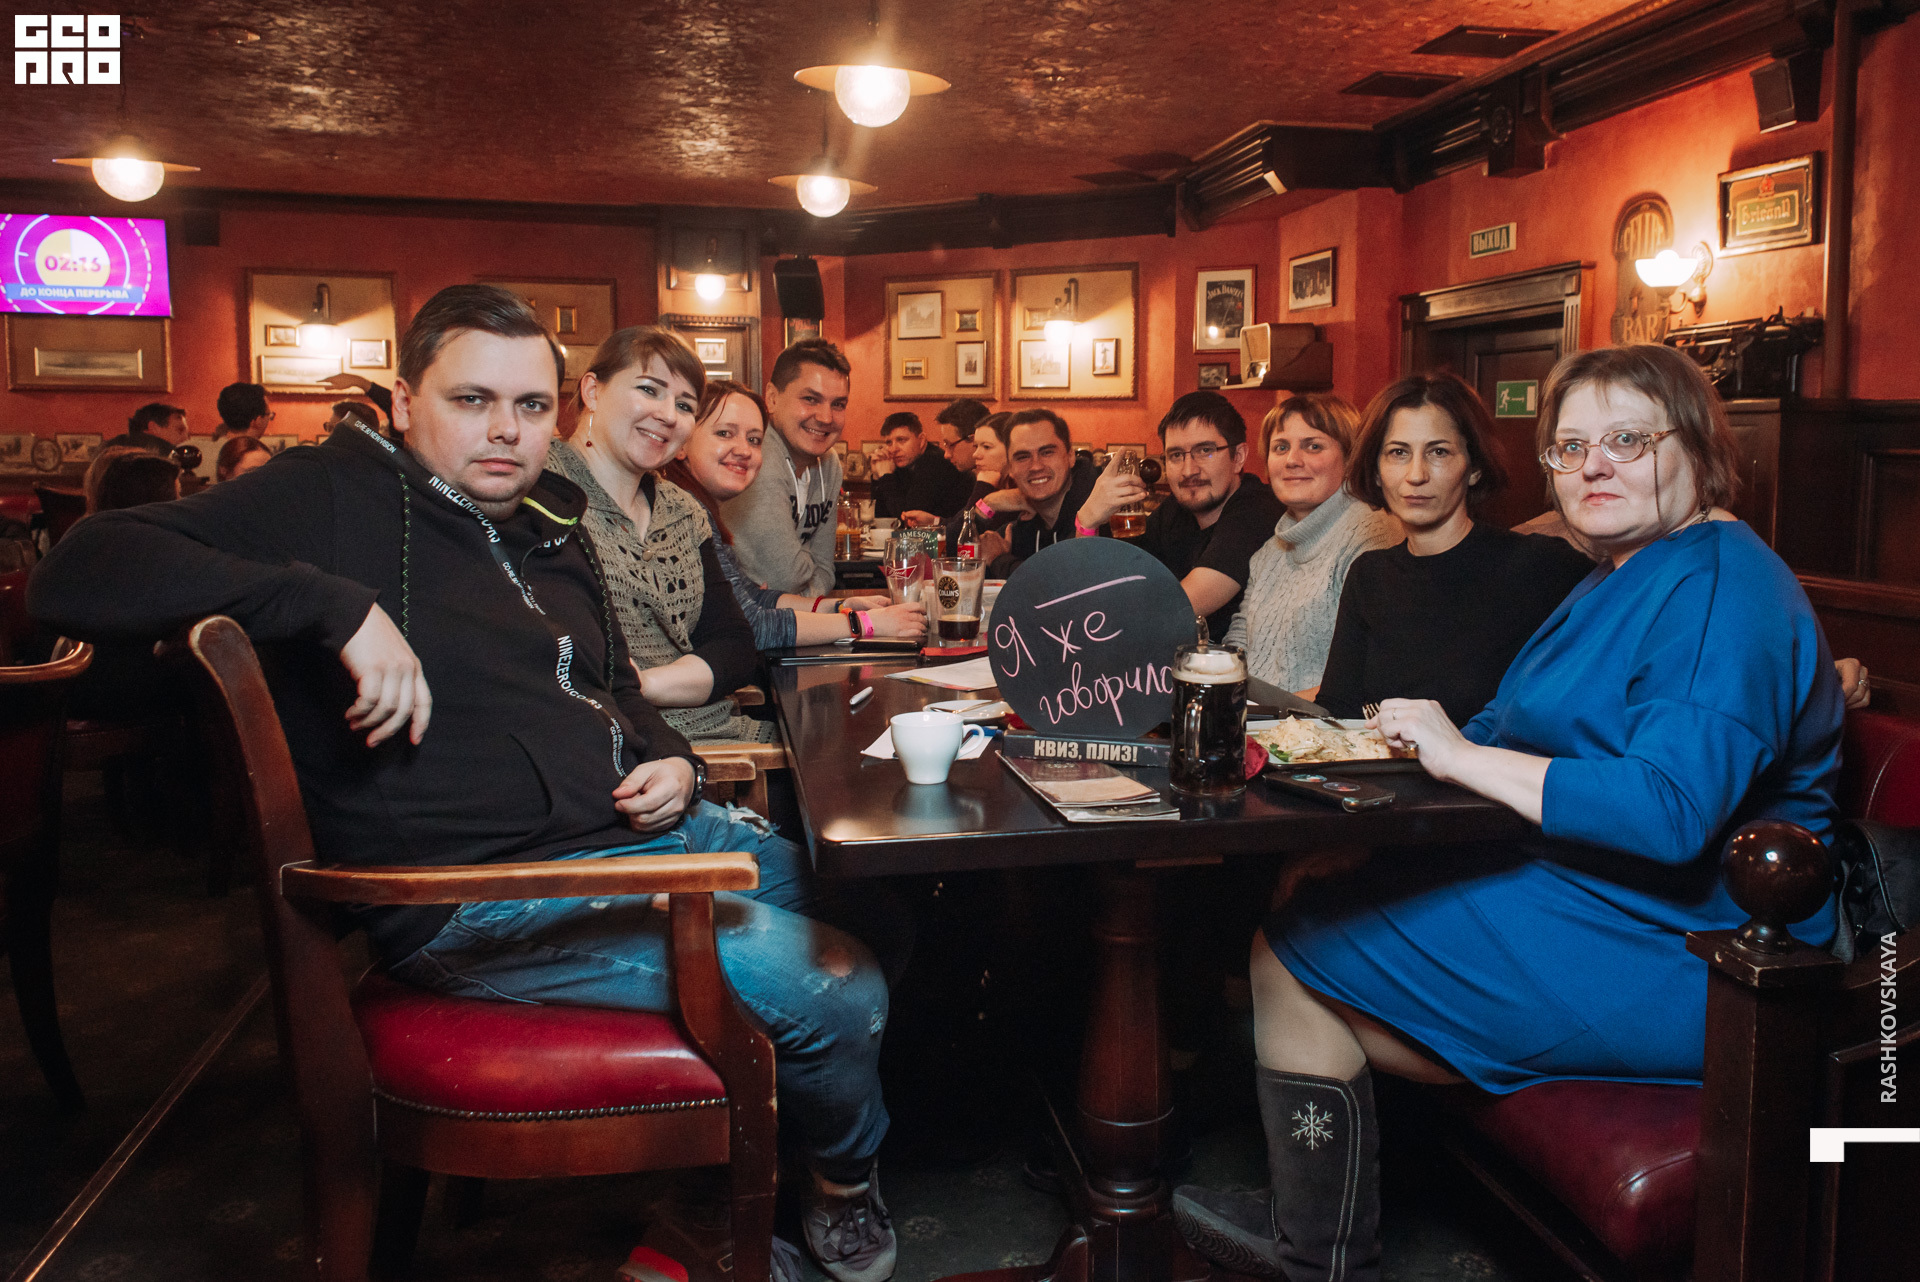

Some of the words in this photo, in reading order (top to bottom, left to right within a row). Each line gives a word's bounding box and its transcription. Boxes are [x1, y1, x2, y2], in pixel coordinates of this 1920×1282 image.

[1473, 228, 1508, 252] ВЫХОД
[44, 255, 102, 272] 02:16
[20, 287, 37, 298] ДО
[38, 287, 75, 299] КОНЦА
[76, 289, 129, 299] ПЕРЕРЫВА
[995, 616, 1036, 677] Я
[1040, 611, 1123, 663] же
[1034, 740, 1082, 760] КВИЗ,
[1086, 743, 1138, 762] ПЛИЗ!
